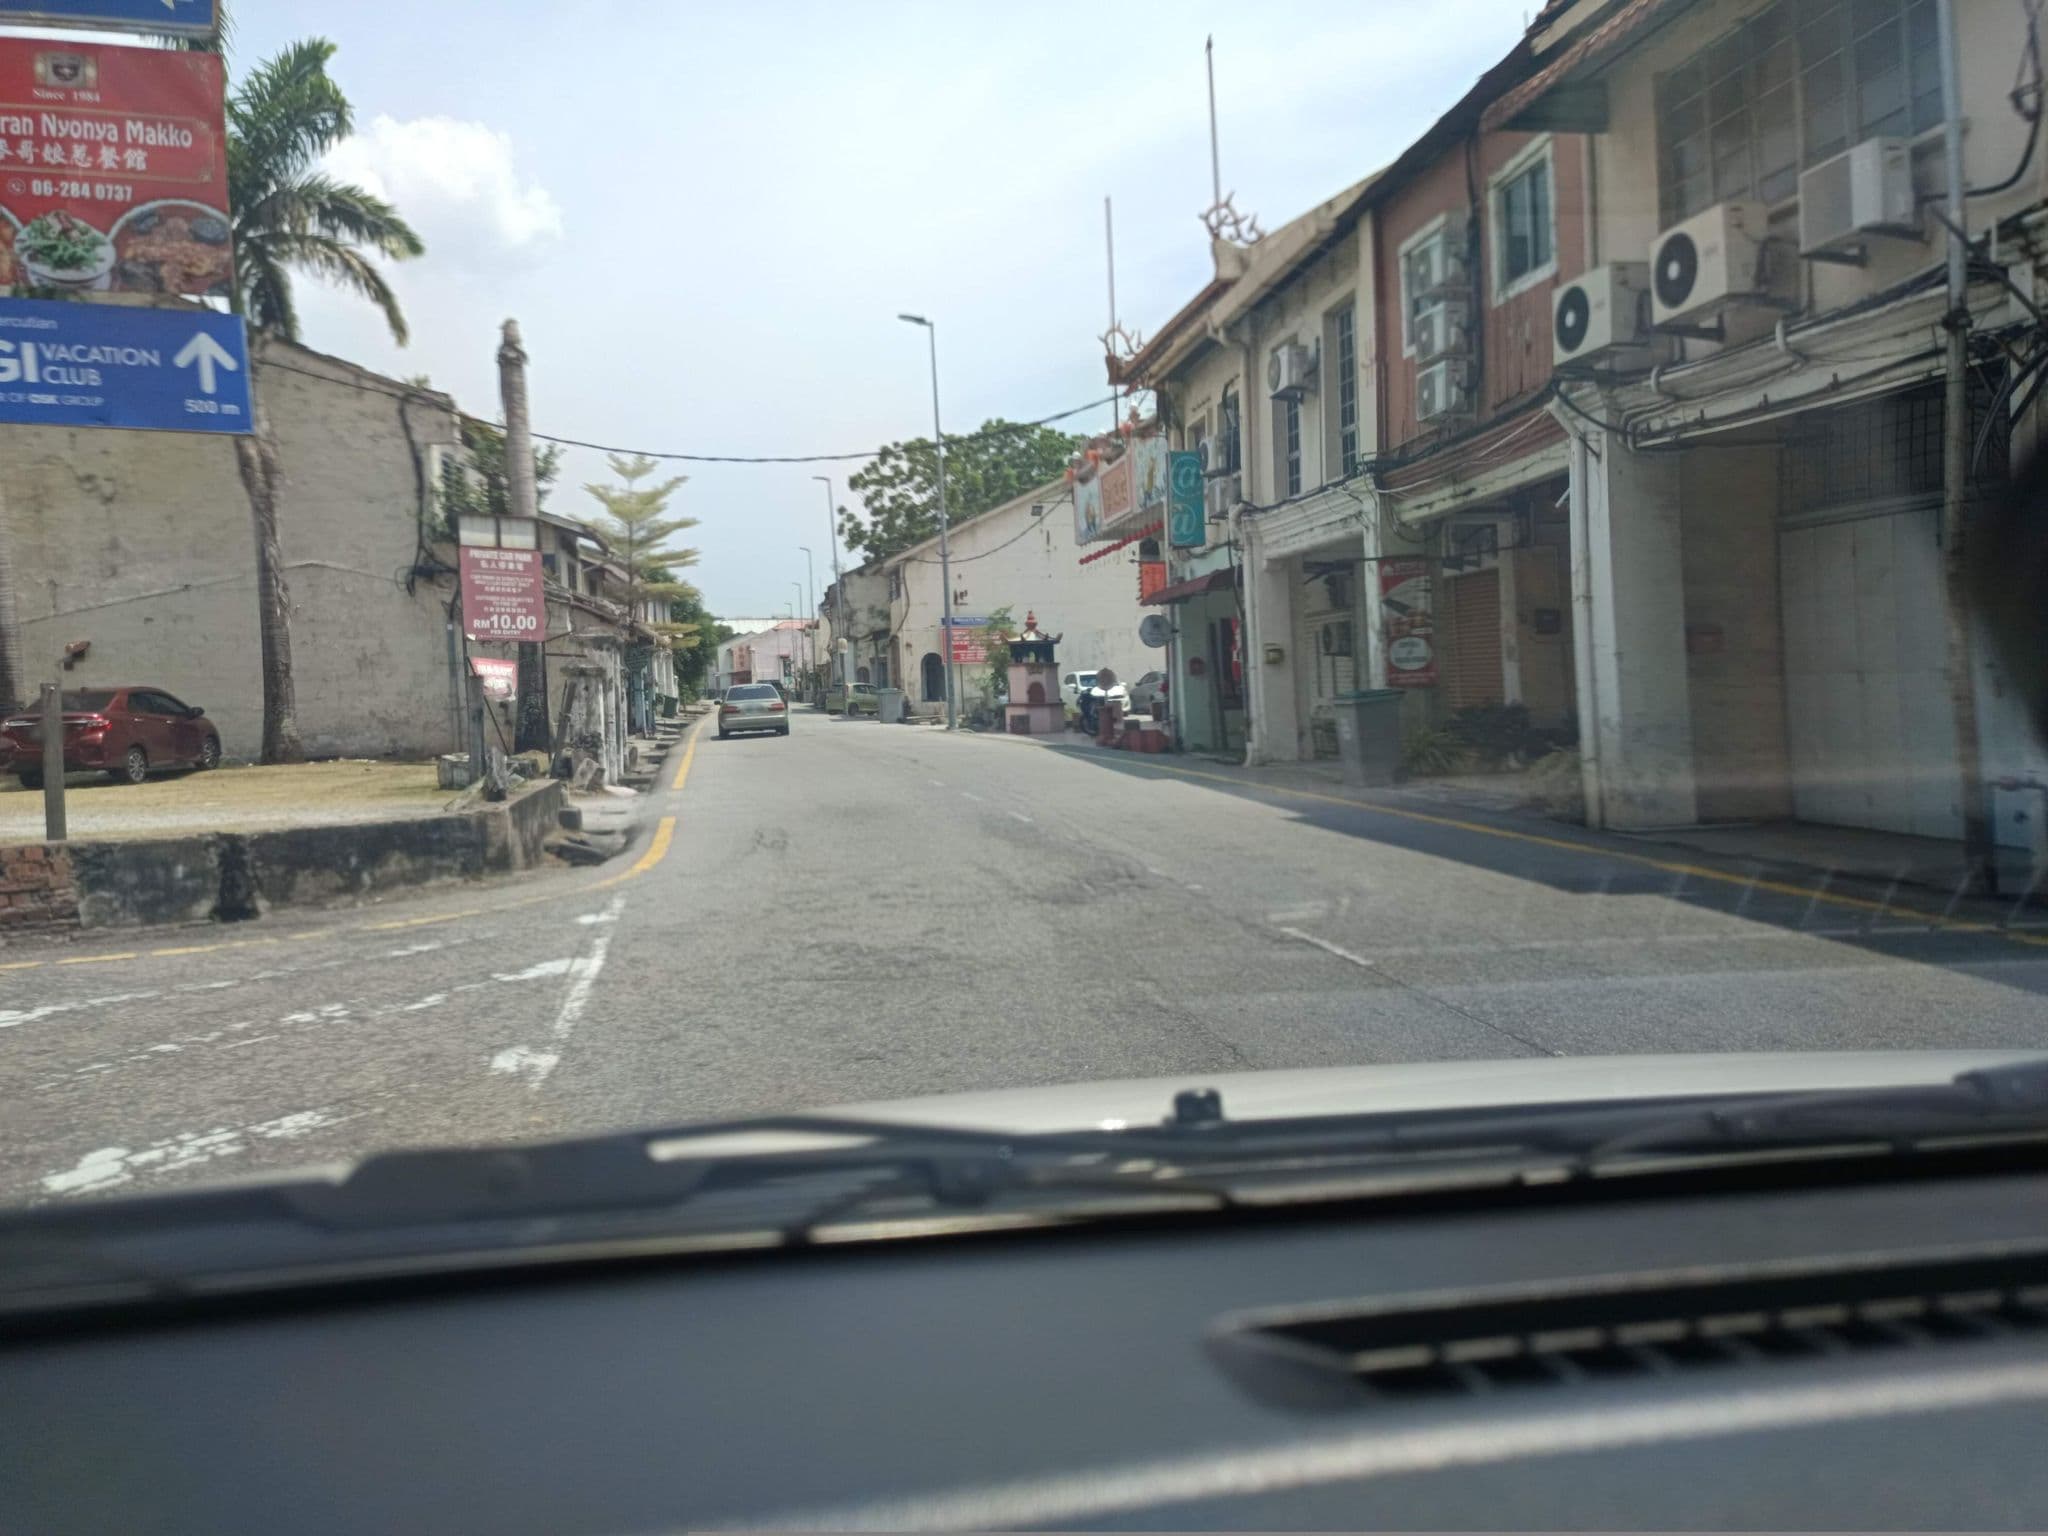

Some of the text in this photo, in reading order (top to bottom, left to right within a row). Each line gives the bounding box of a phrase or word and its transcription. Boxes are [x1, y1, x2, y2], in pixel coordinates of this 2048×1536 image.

[41, 112, 118, 143] Nyonya
[126, 119, 193, 148] Makko
[32, 179, 133, 202] 06-284 0737
[38, 342, 161, 367] VACATION
[42, 365, 102, 386] CLUB
[473, 614, 537, 631] RM10.00
